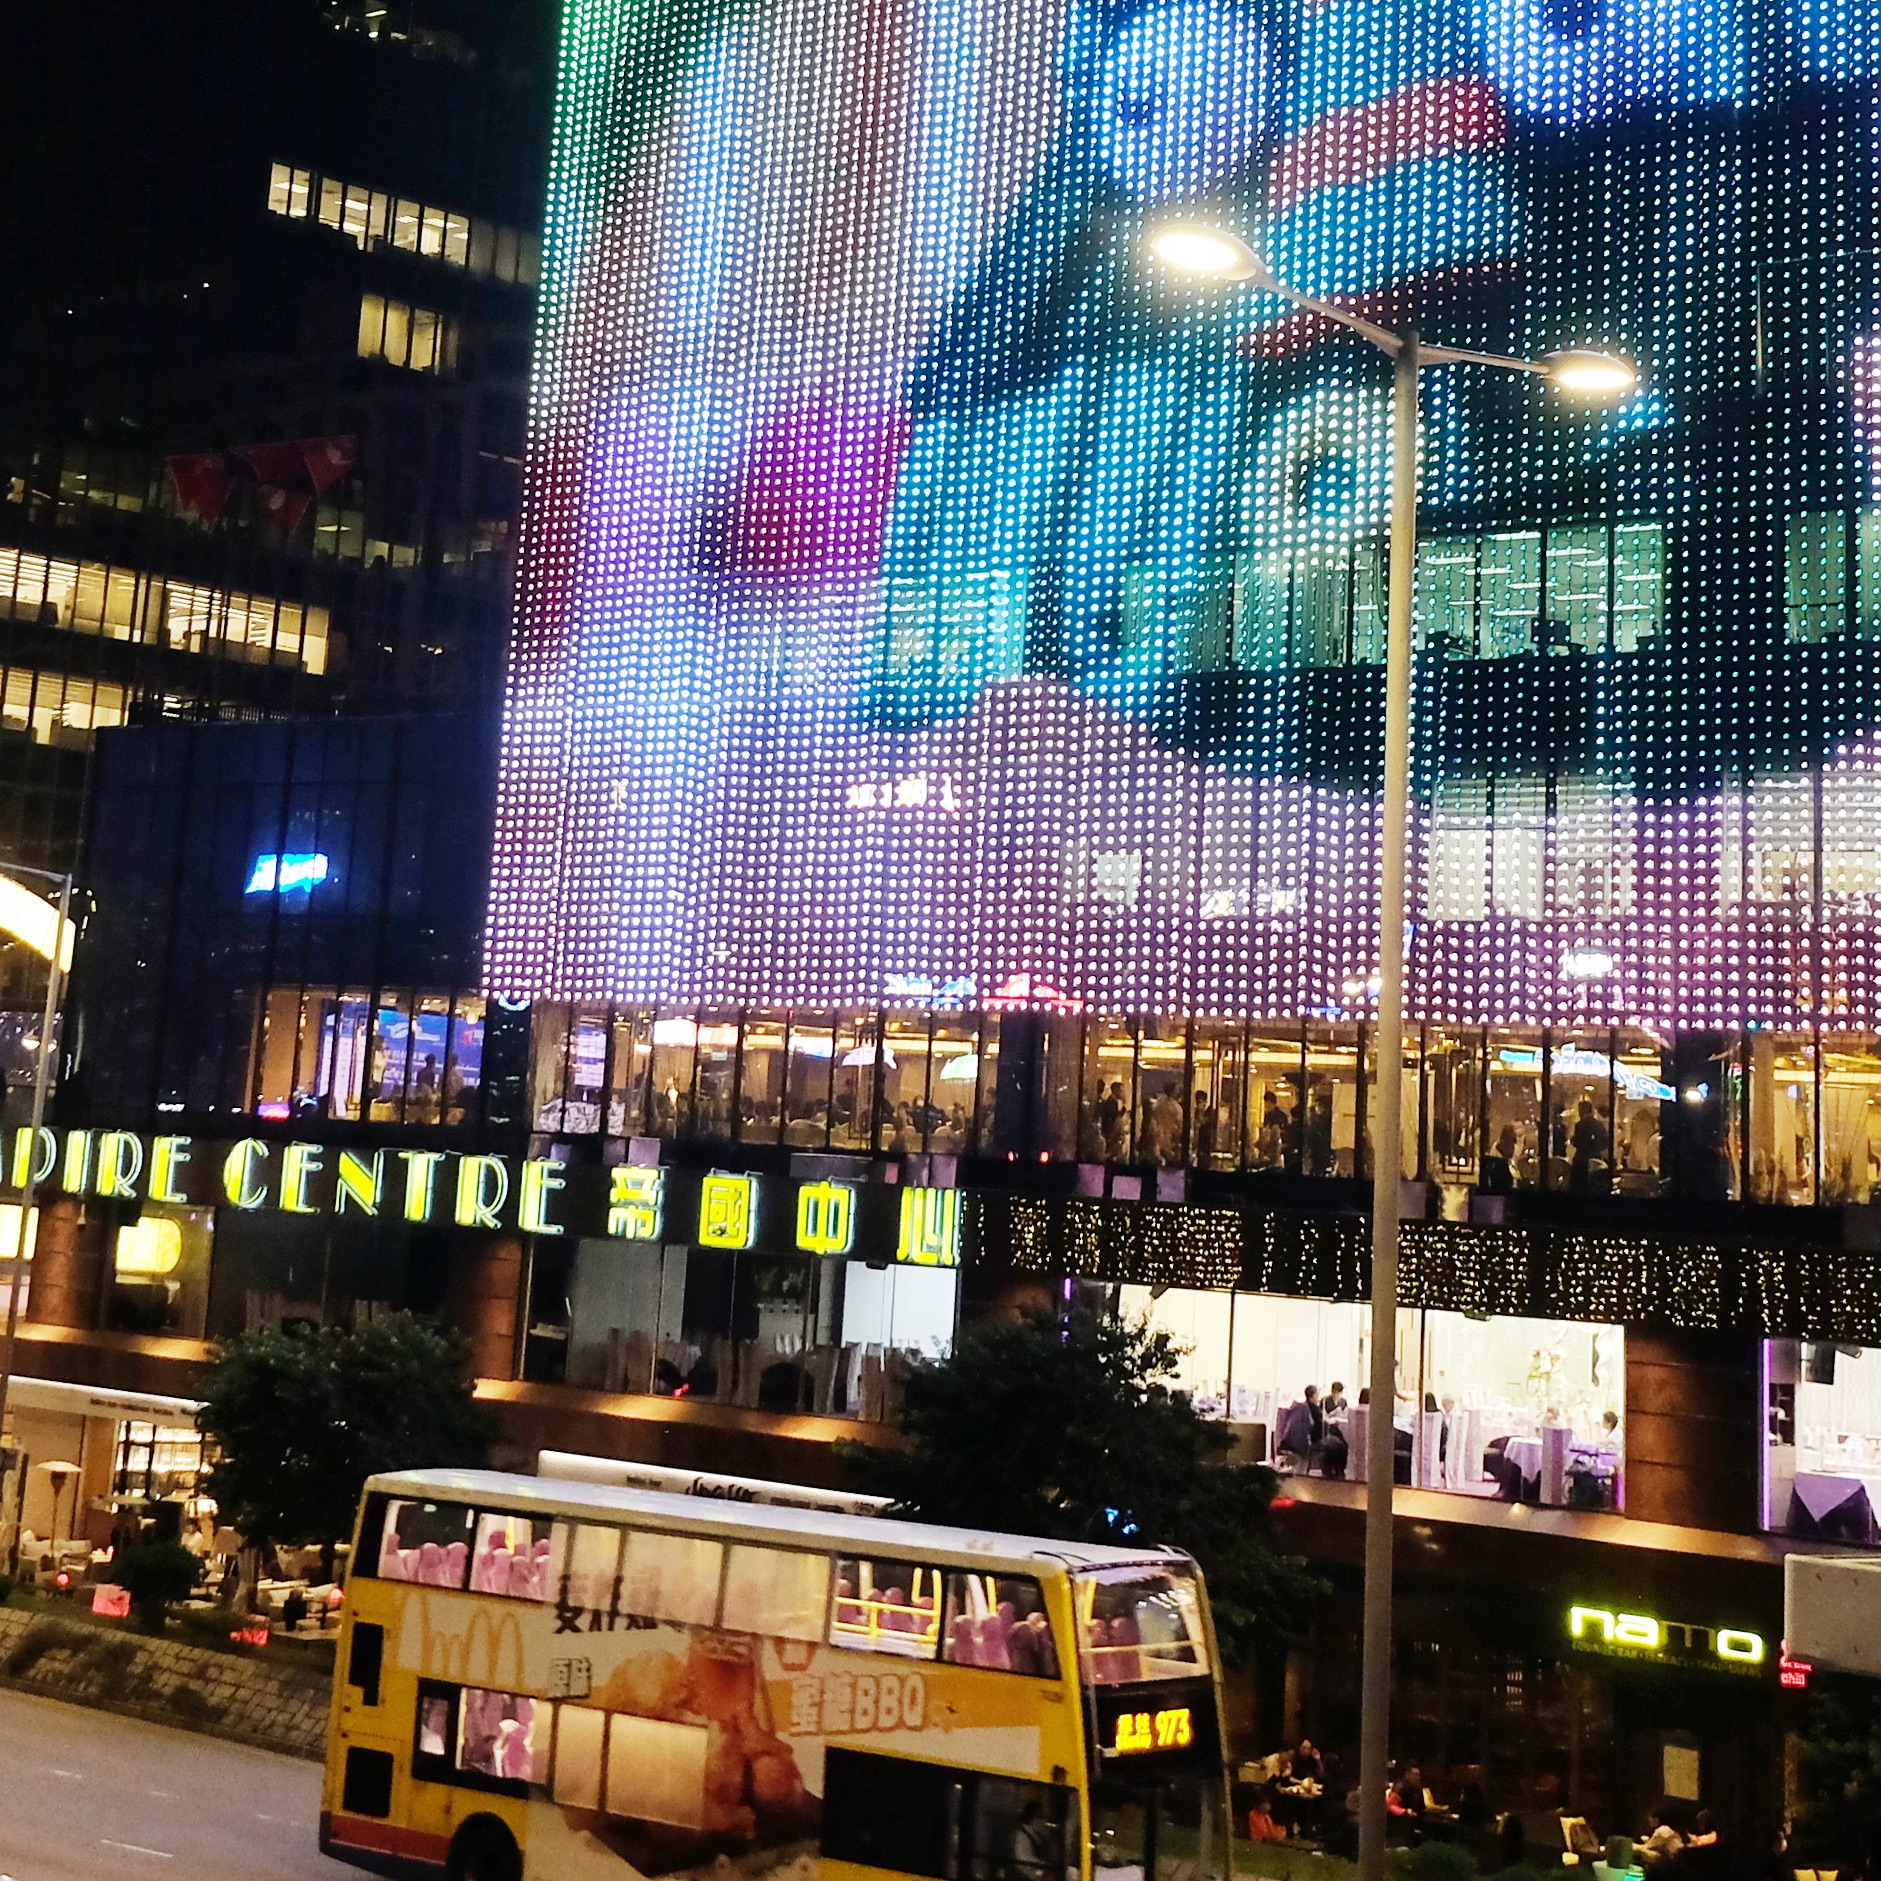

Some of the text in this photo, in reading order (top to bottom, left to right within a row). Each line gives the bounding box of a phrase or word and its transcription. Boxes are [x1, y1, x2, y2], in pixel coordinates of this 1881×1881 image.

[222, 1136, 567, 1235] CENTRE
[606, 1164, 963, 1267] 帝國中心
[1569, 1606, 1764, 1662] namo
[1155, 1708, 1191, 1748] 973
